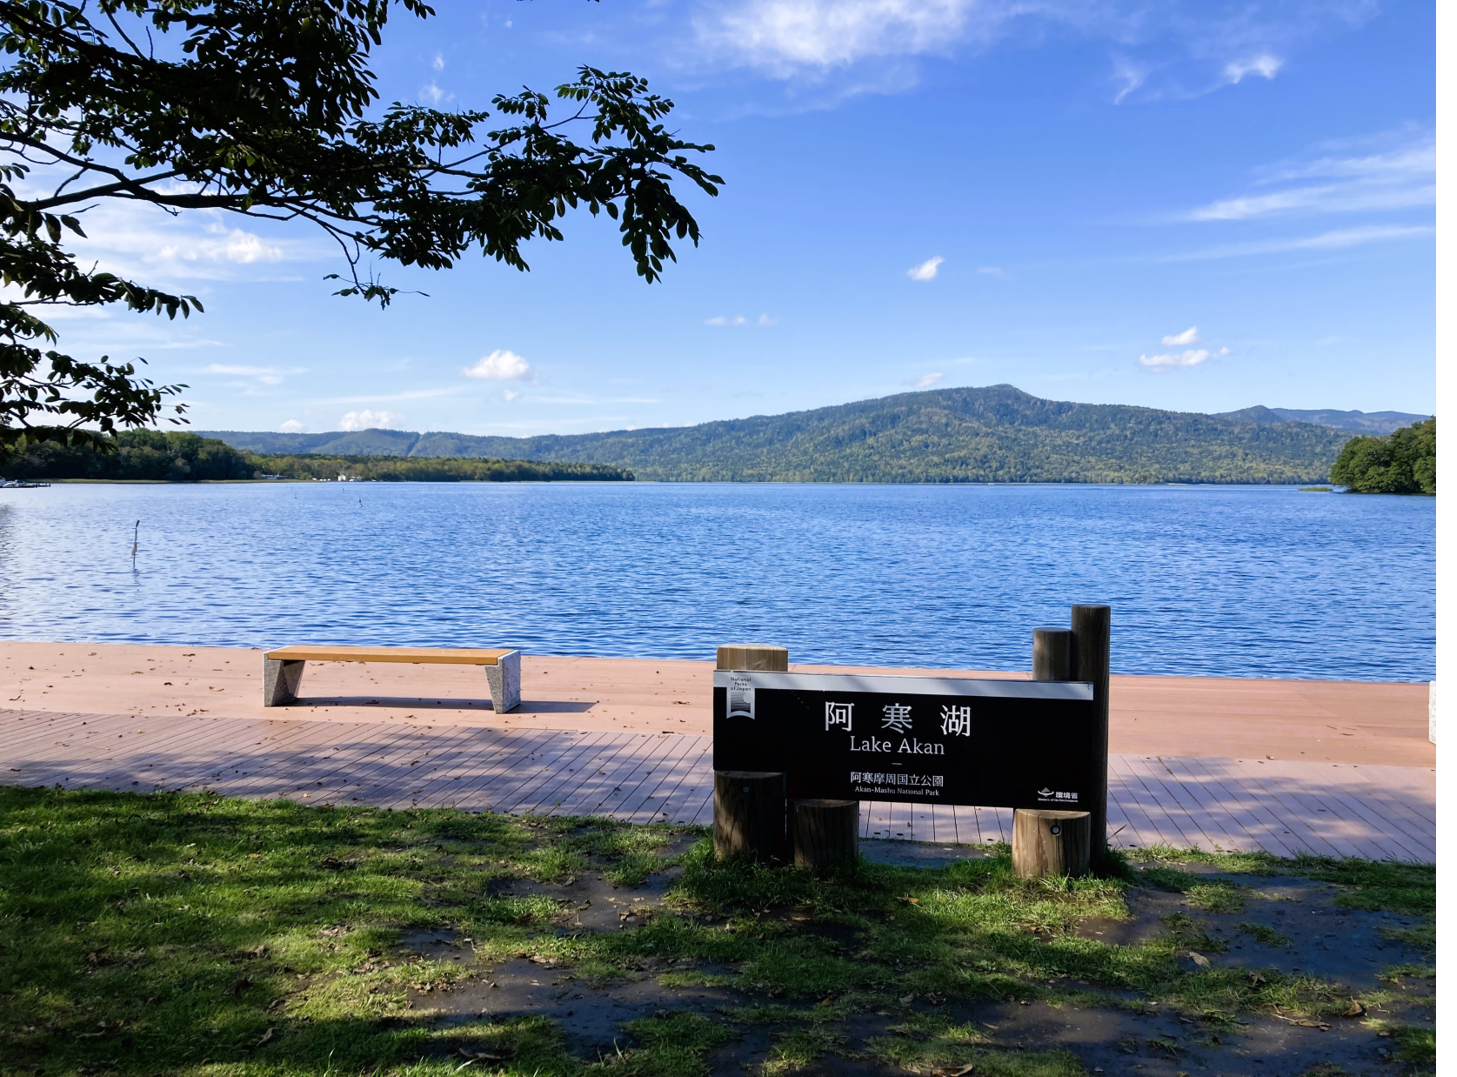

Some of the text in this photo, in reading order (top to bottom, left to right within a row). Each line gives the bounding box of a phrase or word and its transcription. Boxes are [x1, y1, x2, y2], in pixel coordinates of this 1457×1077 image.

[824, 701, 972, 736] 阿寒湖
[850, 736, 945, 755] Lake Akan
[850, 771, 944, 787] 阿寒摩周国立公園
[854, 786, 940, 796] Akan-Mashu National Park
